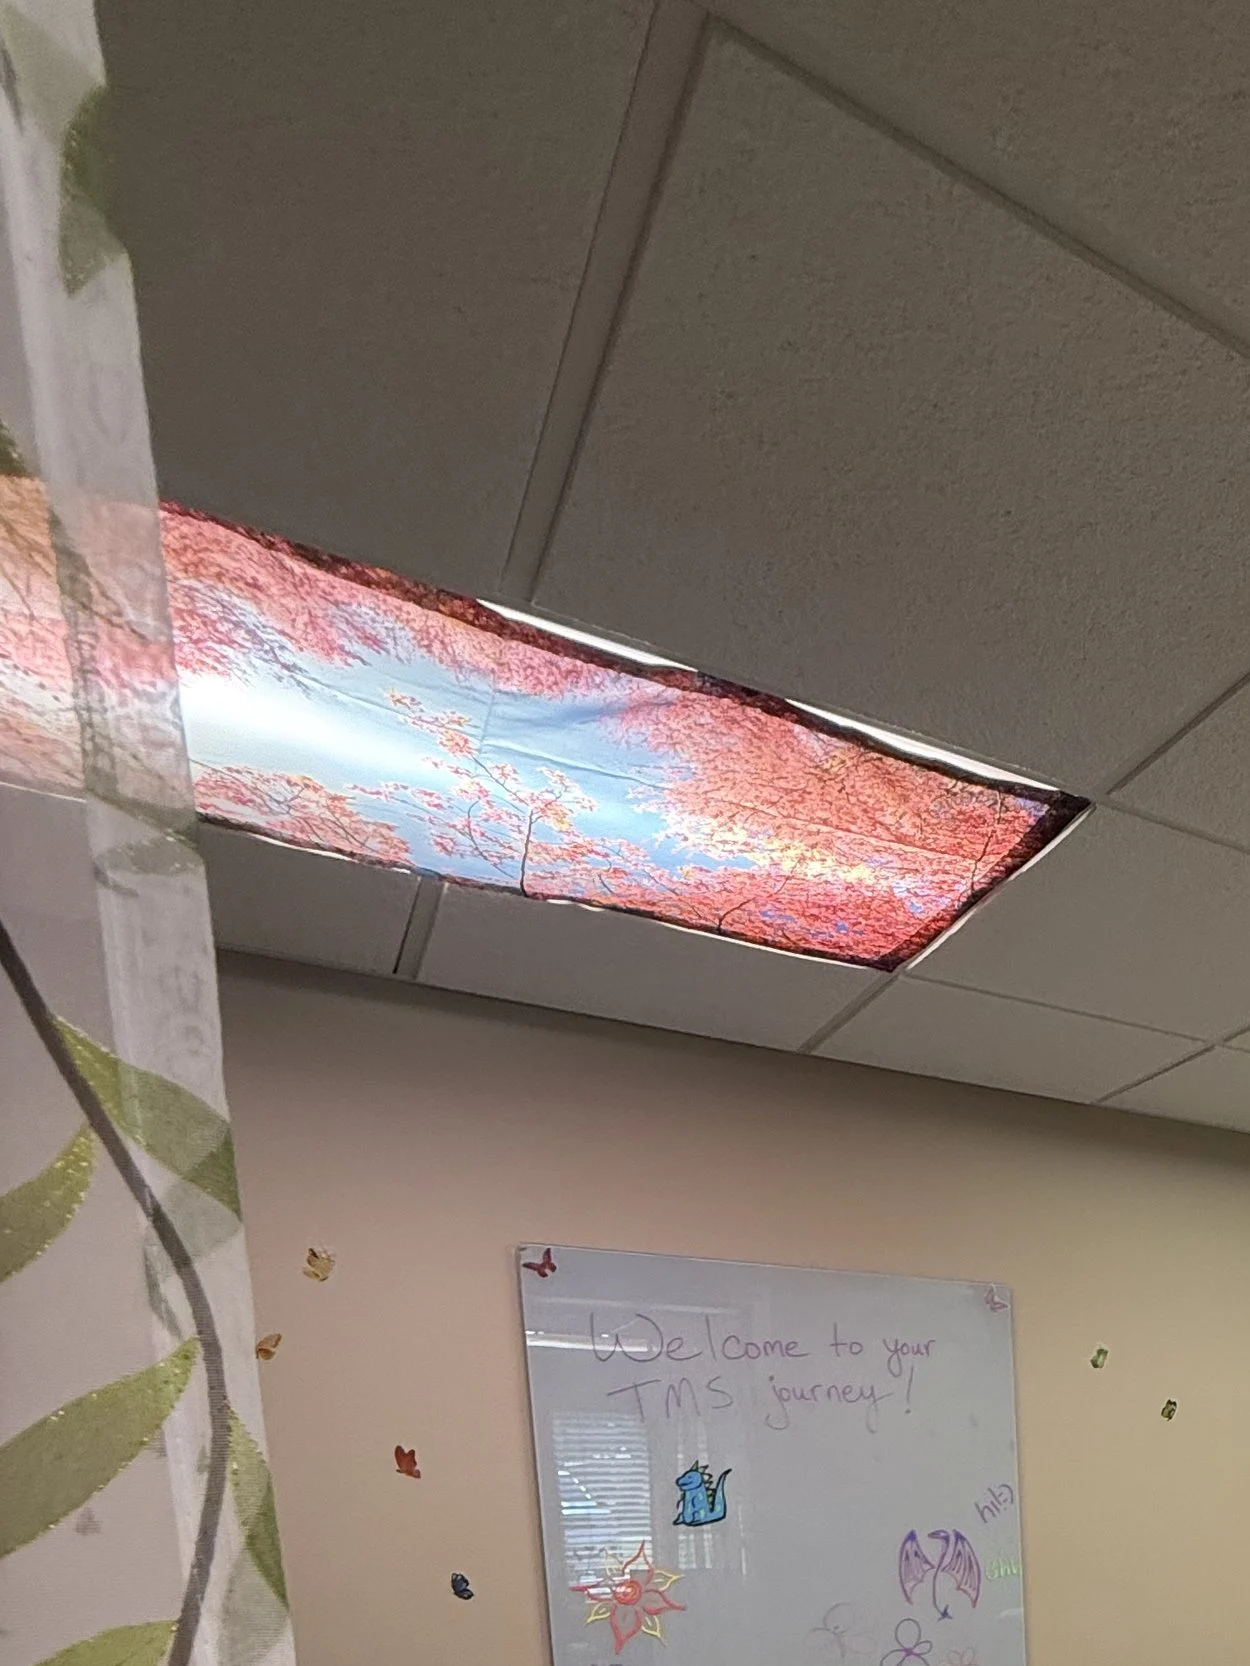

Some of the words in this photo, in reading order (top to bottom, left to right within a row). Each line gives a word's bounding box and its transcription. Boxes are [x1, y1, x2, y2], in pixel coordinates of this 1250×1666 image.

[589, 1312, 810, 1362] Welcome
[829, 1322, 864, 1357] to
[882, 1338, 936, 1378] your
[606, 1375, 734, 1424] TMS
